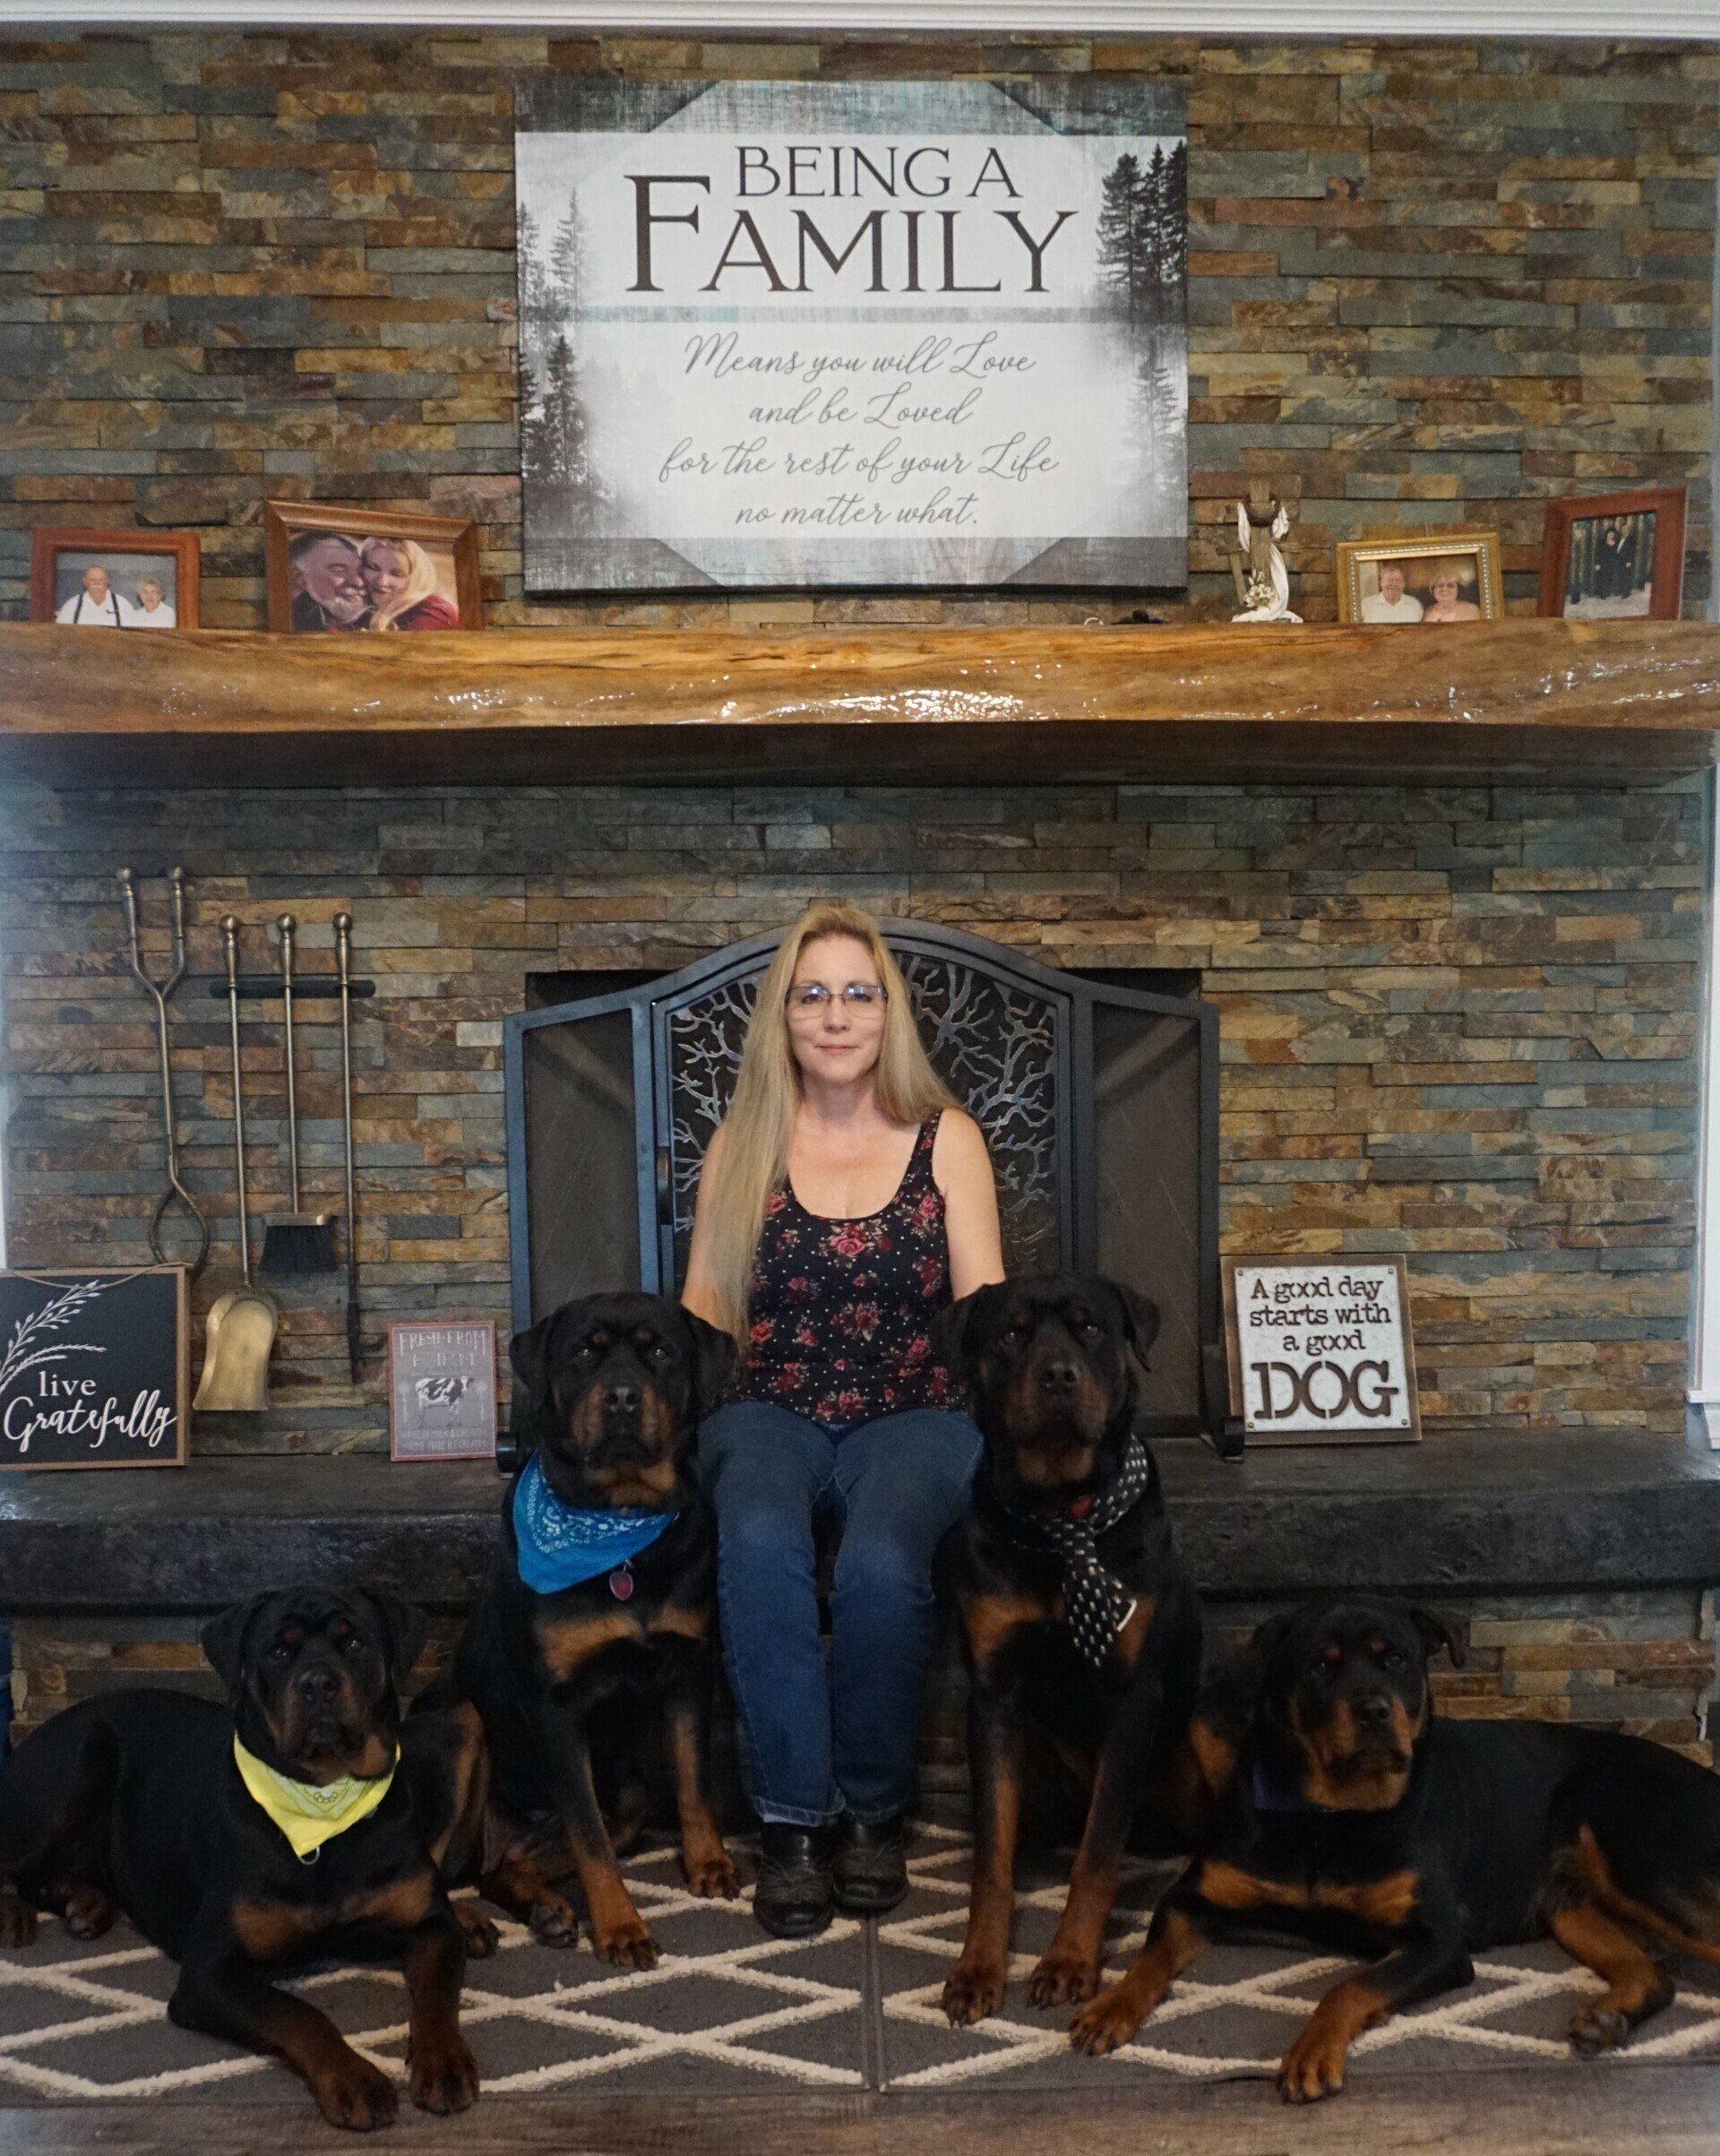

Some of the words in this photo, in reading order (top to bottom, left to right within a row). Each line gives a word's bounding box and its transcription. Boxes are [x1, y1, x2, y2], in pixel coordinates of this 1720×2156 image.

[735, 146, 952, 197] BEING
[966, 147, 1024, 197] A
[624, 175, 1079, 292] FAMILY
[684, 332, 804, 378] Means
[804, 350, 865, 383] you
[872, 336, 951, 374] will
[950, 331, 1036, 378] Love
[749, 387, 821, 425] and
[819, 387, 856, 425] be
[864, 382, 983, 428] Loved
[658, 437, 718, 483] for
[722, 437, 776, 474] the
[785, 446, 854, 475] rest
[856, 437, 902, 483] of
[892, 456, 972, 484] your
[978, 432, 1061, 482] Life
[735, 505, 776, 525] no
[781, 493, 891, 526] matter
[897, 487, 978, 525] what.
[1251, 1278, 1269, 1299] A
[1274, 1277, 1334, 1304] good
[1338, 1275, 1384, 1301] day
[1250, 1305, 1329, 1327] starts
[1335, 1303, 1391, 1324] with
[1283, 1334, 1300, 1351] a
[1306, 1329, 1366, 1356] good
[39, 1370, 97, 1397] live
[1251, 1359, 1399, 1419] DOG
[4, 1389, 177, 1453] Gratefully
